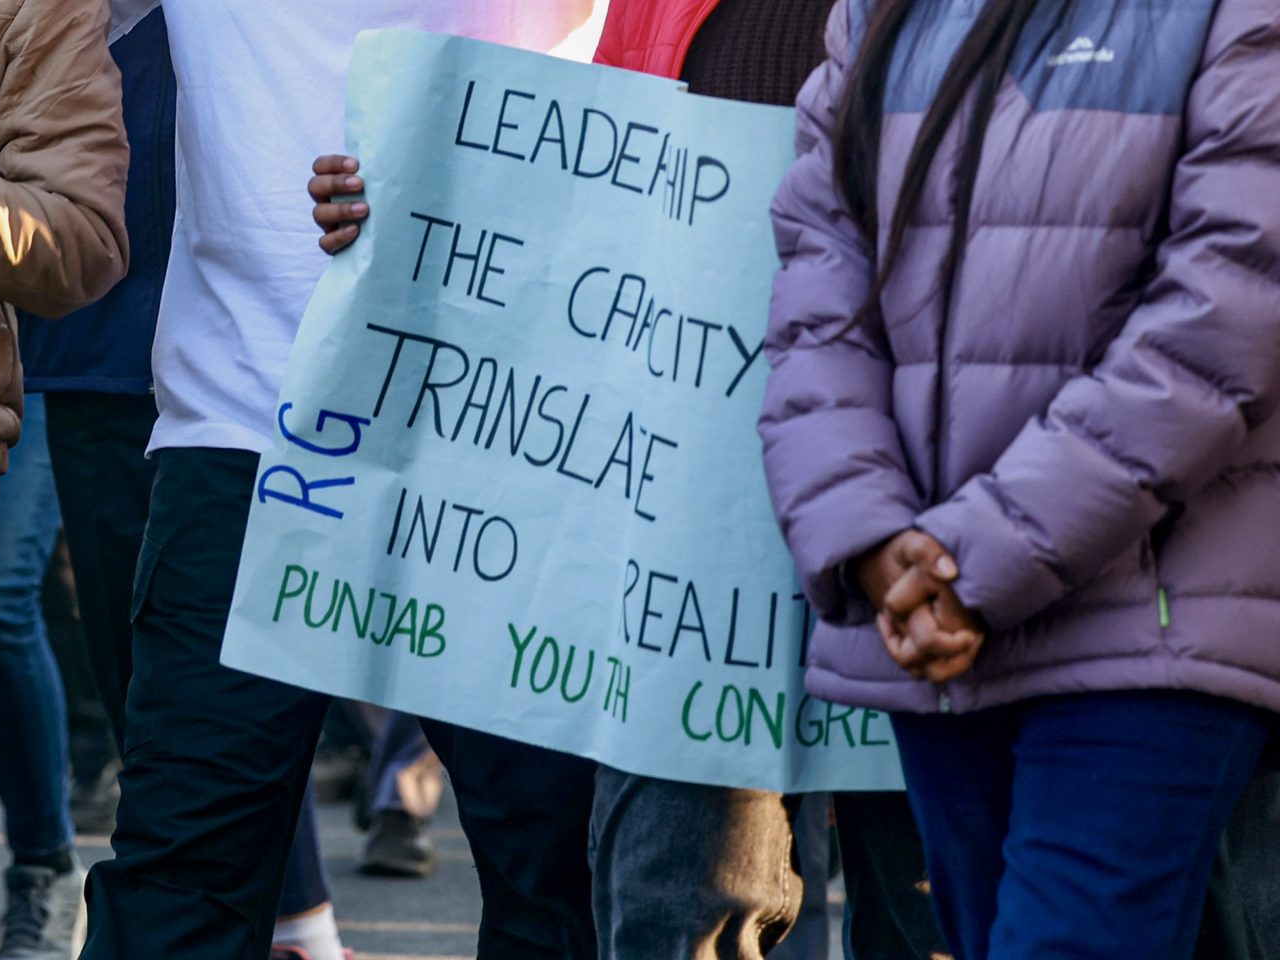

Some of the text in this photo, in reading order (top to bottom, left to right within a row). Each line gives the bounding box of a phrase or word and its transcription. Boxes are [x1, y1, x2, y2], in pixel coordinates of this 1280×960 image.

[410, 212, 524, 308] THE
[257, 401, 371, 520] RG
[386, 488, 518, 582] INTO
[272, 565, 446, 658] PUNJAB
[508, 622, 631, 723] YOUTH
